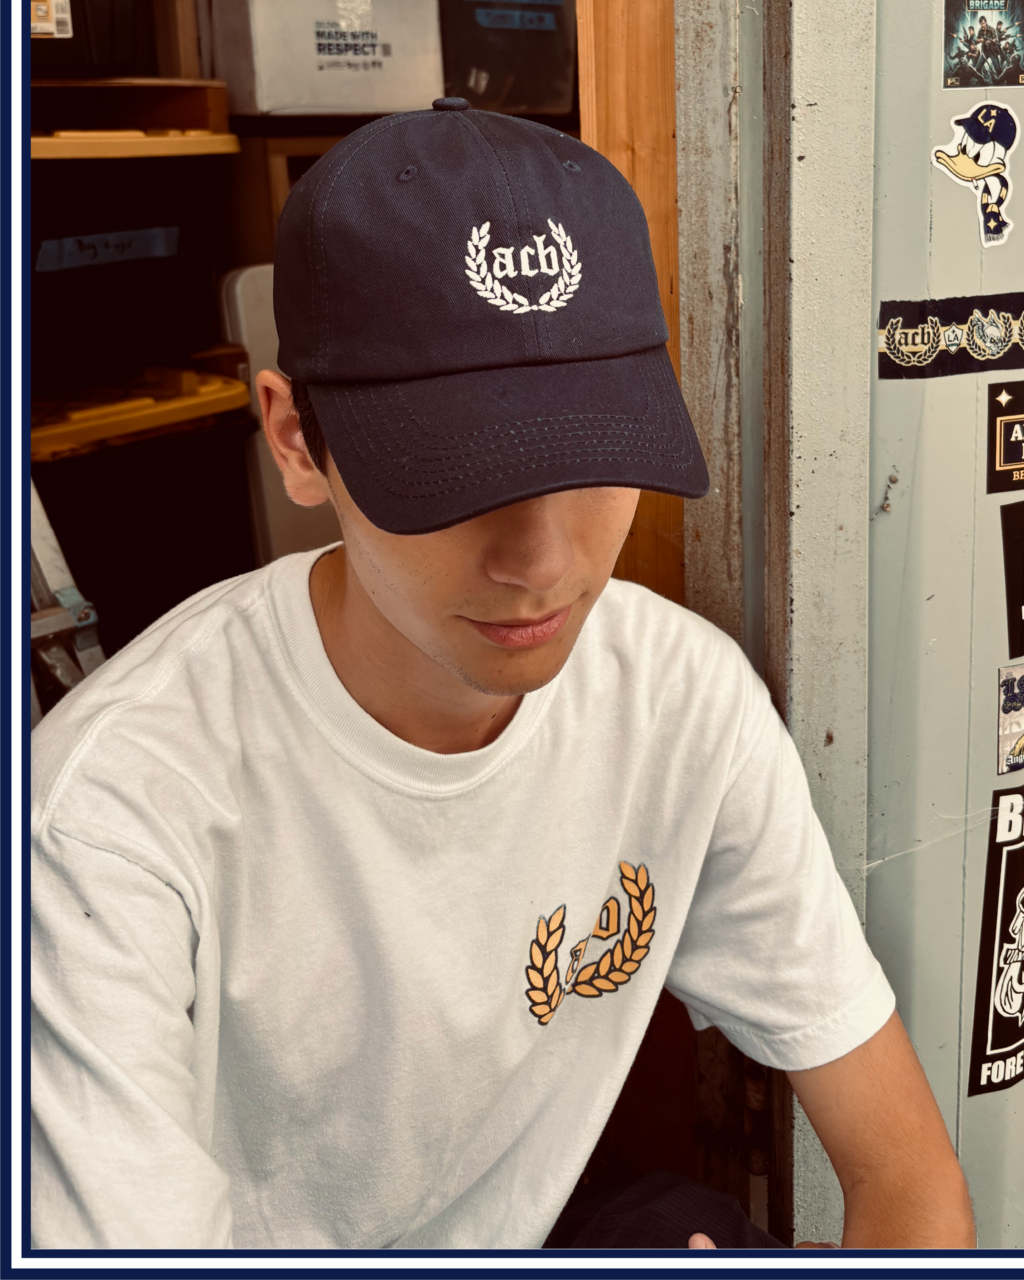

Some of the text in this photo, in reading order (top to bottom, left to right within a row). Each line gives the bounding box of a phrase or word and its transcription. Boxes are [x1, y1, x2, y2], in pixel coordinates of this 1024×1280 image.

[969, 0, 1006, 10] BRIGADE
[315, 30, 378, 41] MADE WITH
[315, 42, 378, 56] RESPECT
[977, 107, 997, 133] LA
[493, 234, 560, 280] acb
[898, 324, 931, 348] acb
[947, 333, 959, 343] LA
